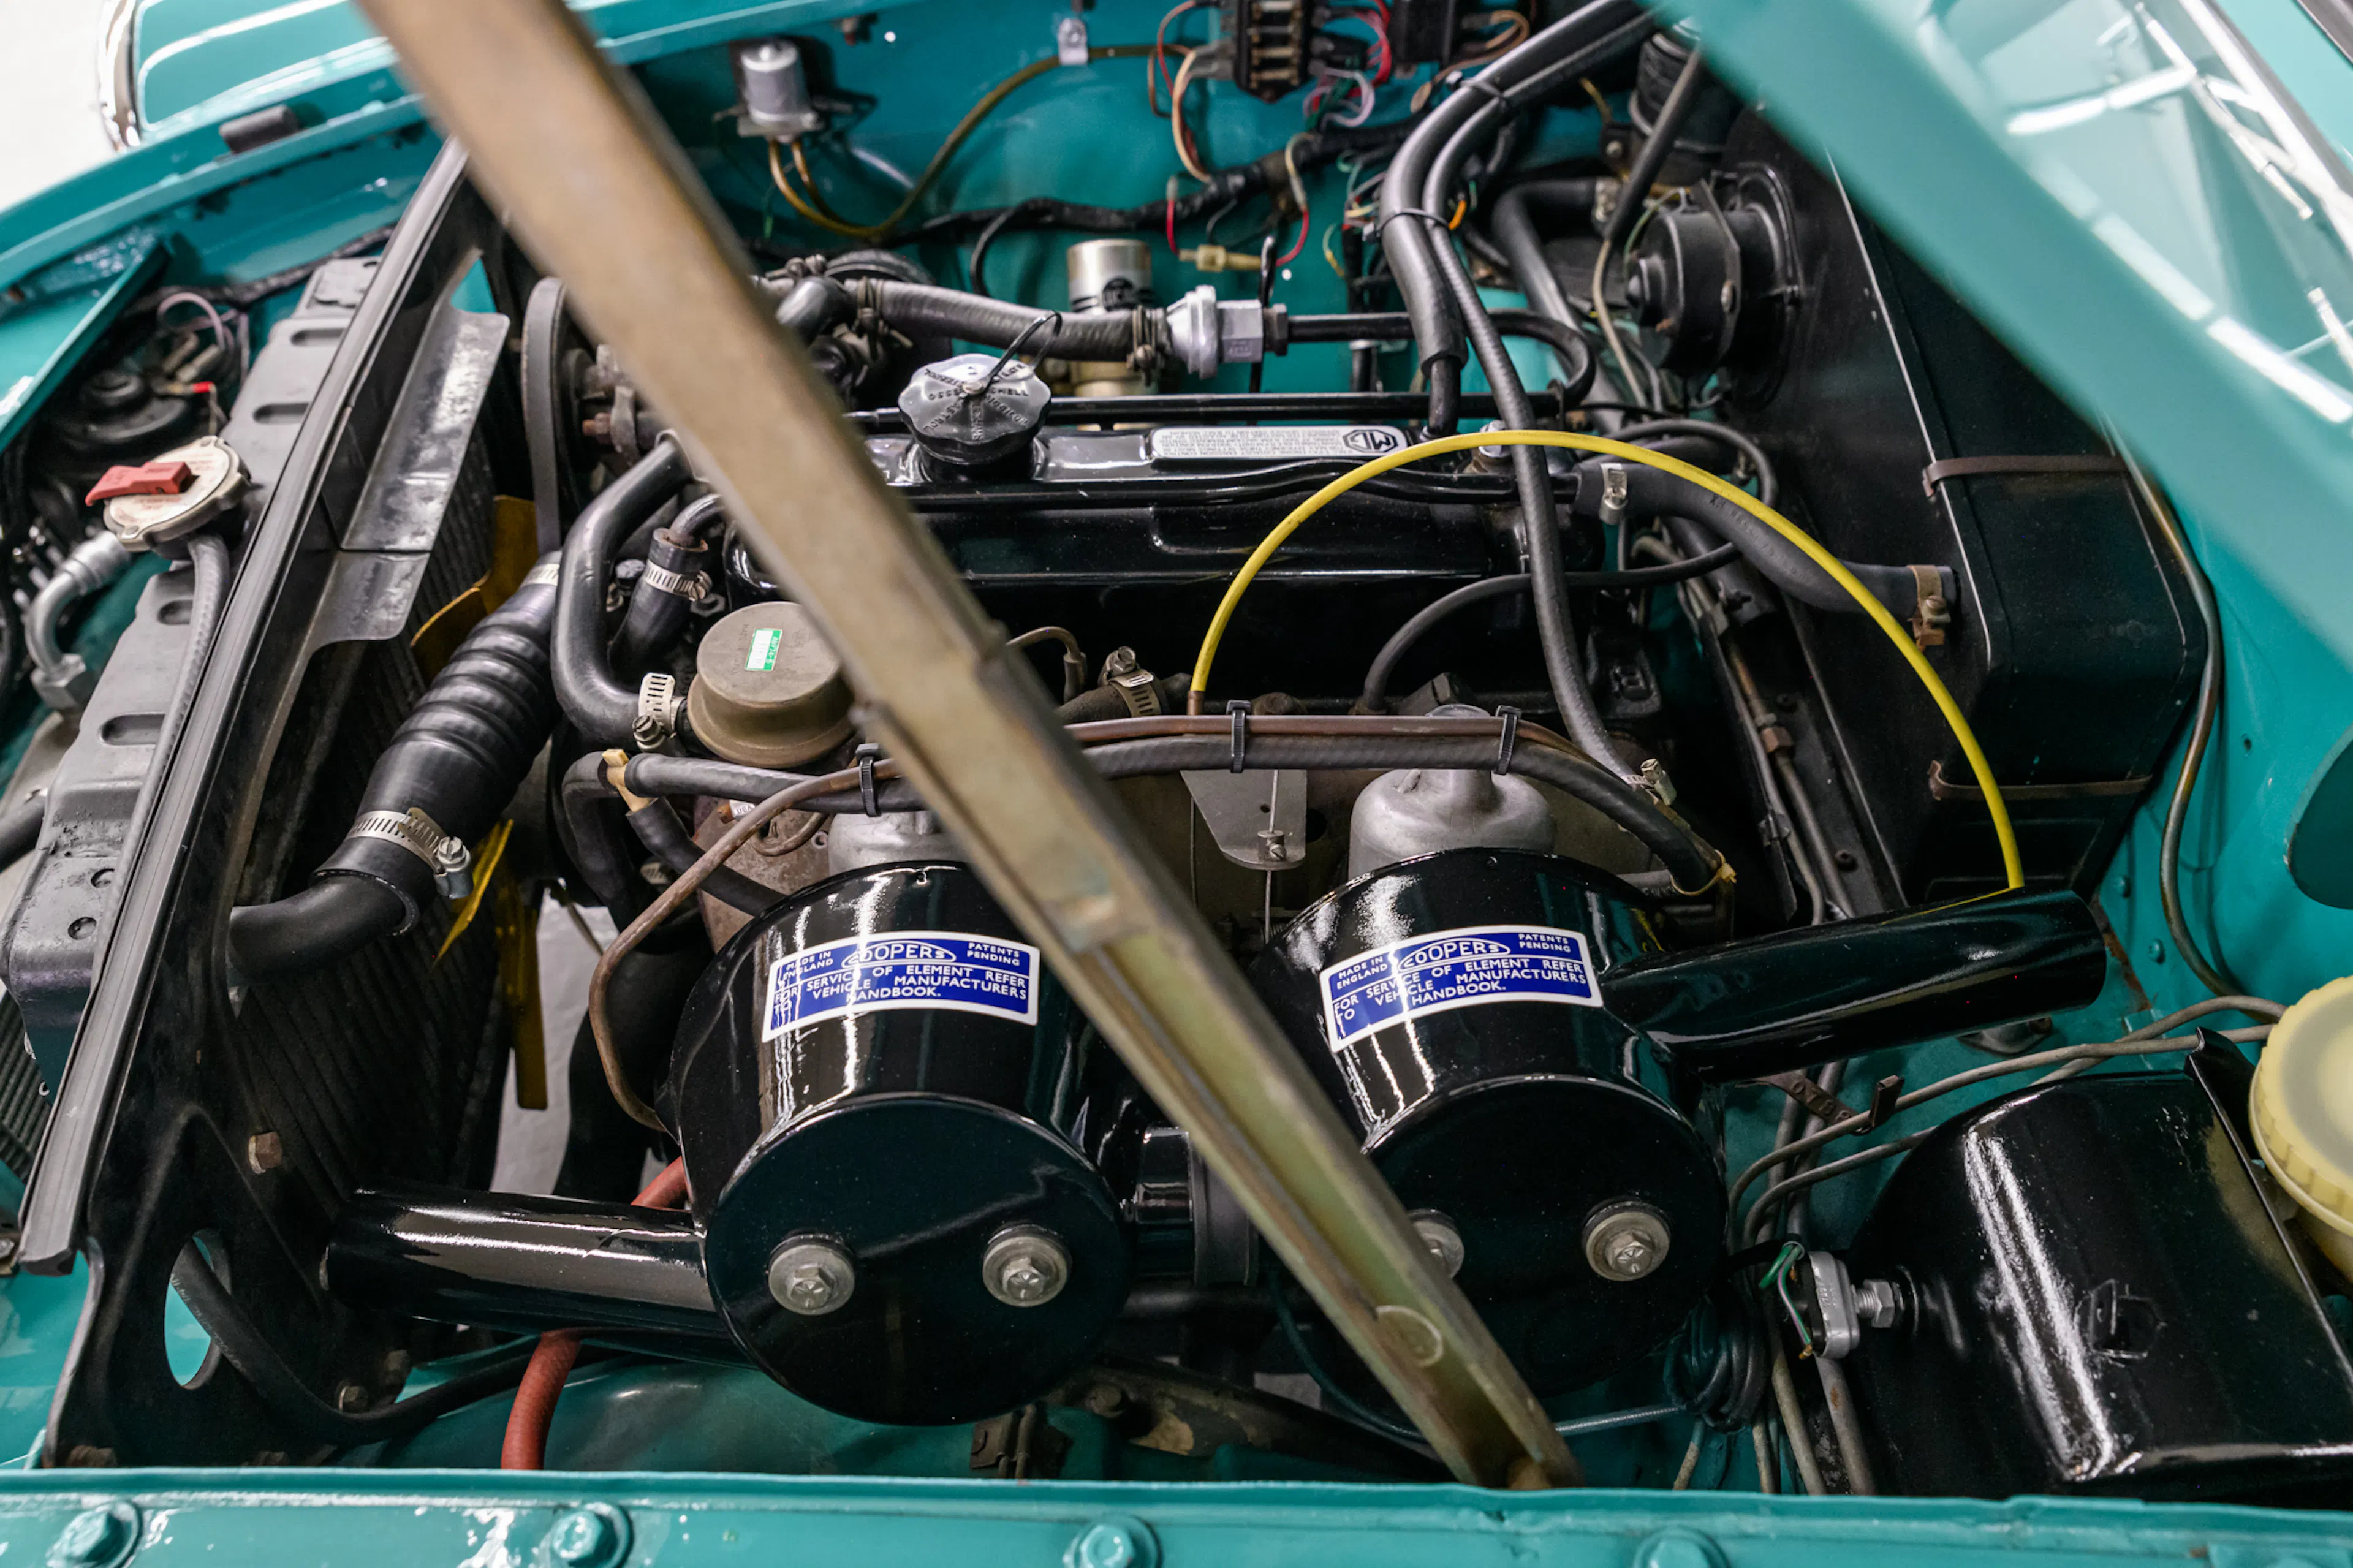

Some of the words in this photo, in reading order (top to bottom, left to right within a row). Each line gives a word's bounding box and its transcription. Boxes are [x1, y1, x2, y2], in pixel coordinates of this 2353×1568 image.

[1347, 431, 1393, 452] MG
[968, 942, 1020, 958] PATENTS
[1518, 933, 1568, 944] PATENTS
[1519, 941, 1571, 953] PENDING
[818, 950, 832, 960] IN
[967, 950, 1020, 966] PENDING
[1403, 941, 1499, 968] COOPERS
[806, 970, 860, 992] SERVIC
[872, 966, 893, 977] OF
[906, 964, 974, 977] ELEMENT
[985, 970, 1026, 989] REFER
[1336, 963, 1387, 990] ENGLAND
[1338, 961, 1367, 980] MADE
[1371, 956, 1383, 966] IN
[894, 975, 1027, 1000] MANUFACTURERS
[1334, 995, 1359, 1011] FOR
[1366, 972, 1420, 999] SERVCE
[1431, 965, 1452, 977] OF
[1464, 958, 1530, 972] ELEMENT
[1542, 960, 1583, 974] REFER
[1336, 1008, 1355, 1021] TO
[1374, 980, 1434, 1006] VEHCLE
[1455, 969, 1586, 985] MANUFACTURERS
[1411, 980, 1506, 1006] HANDBOOK.
